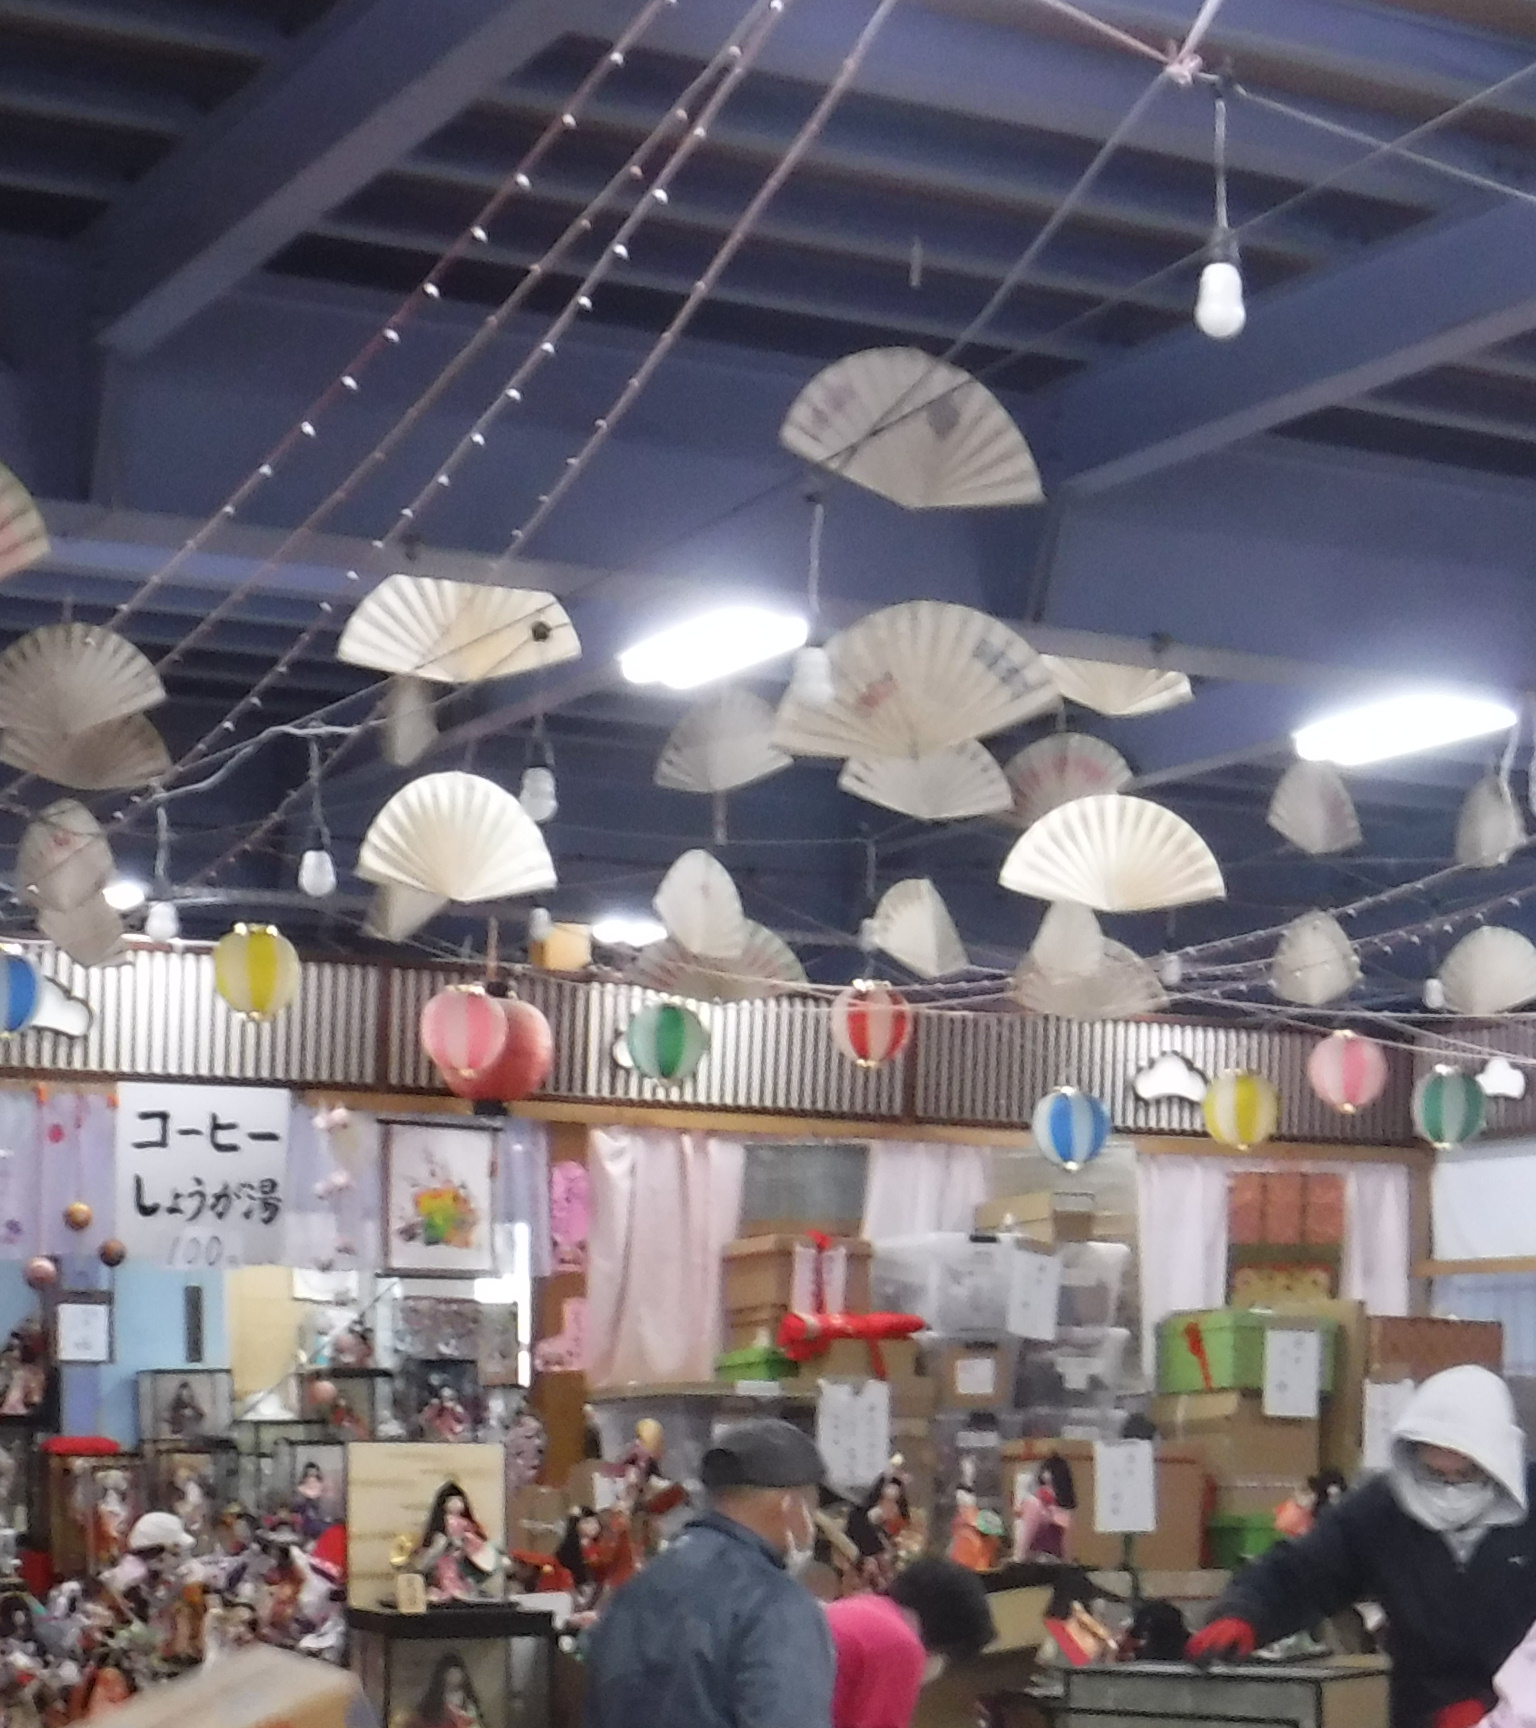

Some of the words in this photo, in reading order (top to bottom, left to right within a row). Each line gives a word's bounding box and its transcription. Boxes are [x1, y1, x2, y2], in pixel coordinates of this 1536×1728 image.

[131, 1110, 281, 1152] コーヒー
[133, 1173, 283, 1225] しょうが湯
